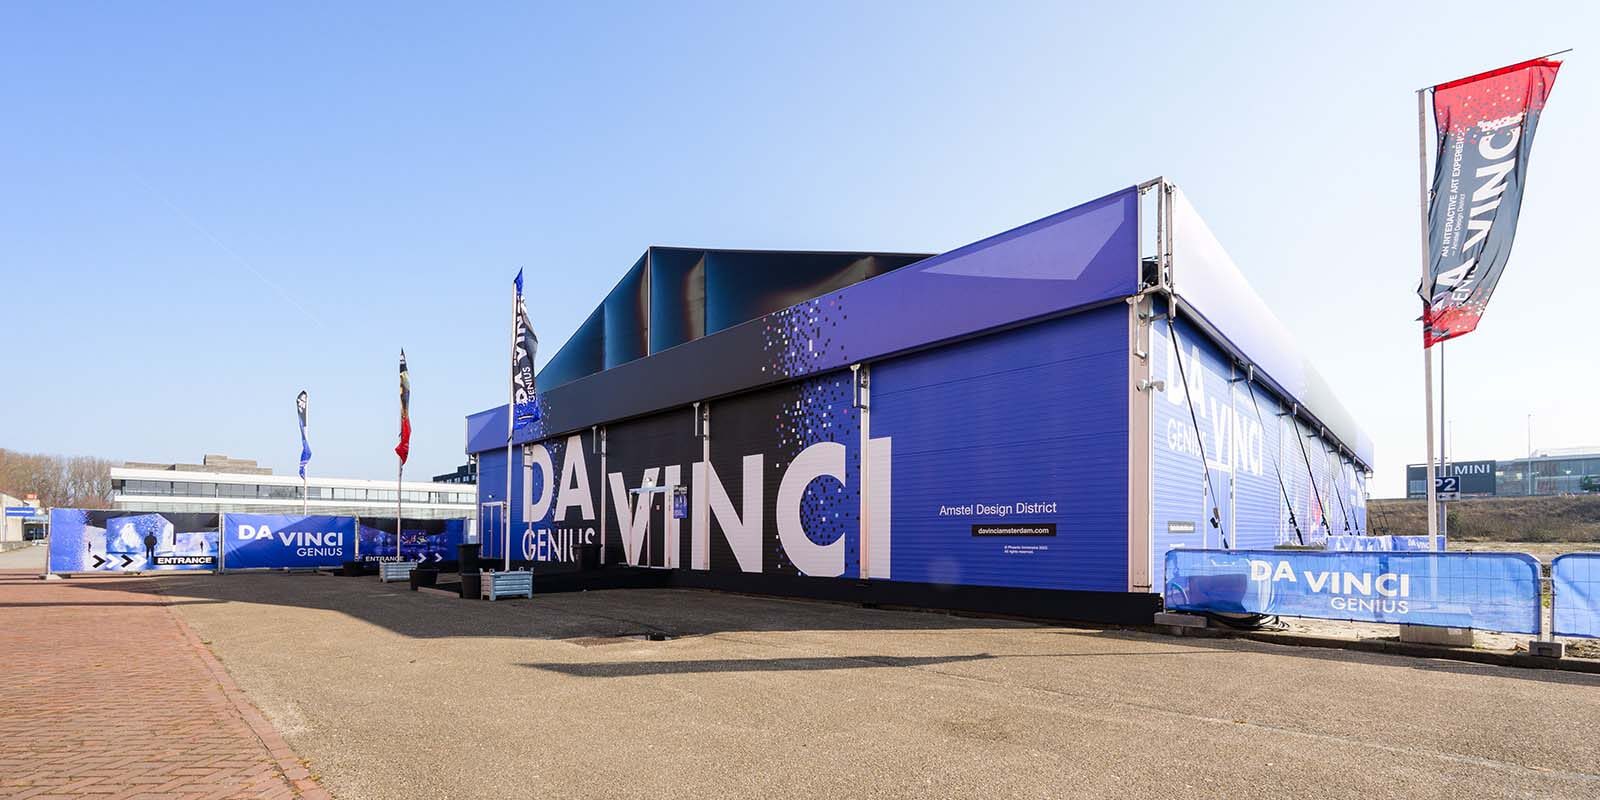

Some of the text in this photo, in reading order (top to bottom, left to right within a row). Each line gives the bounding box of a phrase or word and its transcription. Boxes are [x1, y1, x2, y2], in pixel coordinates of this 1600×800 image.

[1450, 180, 1460, 194] ART
[1442, 194, 1457, 245] INTERACTIVE
[1441, 246, 1449, 258] AN
[515, 371, 529, 407] DA
[1167, 323, 1263, 476] DA VINCI
[1454, 464, 1490, 475] MINI
[1434, 478, 1456, 492] P2
[523, 434, 892, 579] DA VINCI
[939, 501, 1057, 517] Amstel Design District
[238, 524, 343, 547] DA VINCI
[978, 527, 1050, 535] davinciamsterdam.com
[157, 556, 212, 564] ENTRANCE
[296, 547, 343, 557] GENIUS
[1250, 559, 1410, 598] DA VINCI
[1331, 597, 1409, 614] GENIUS
